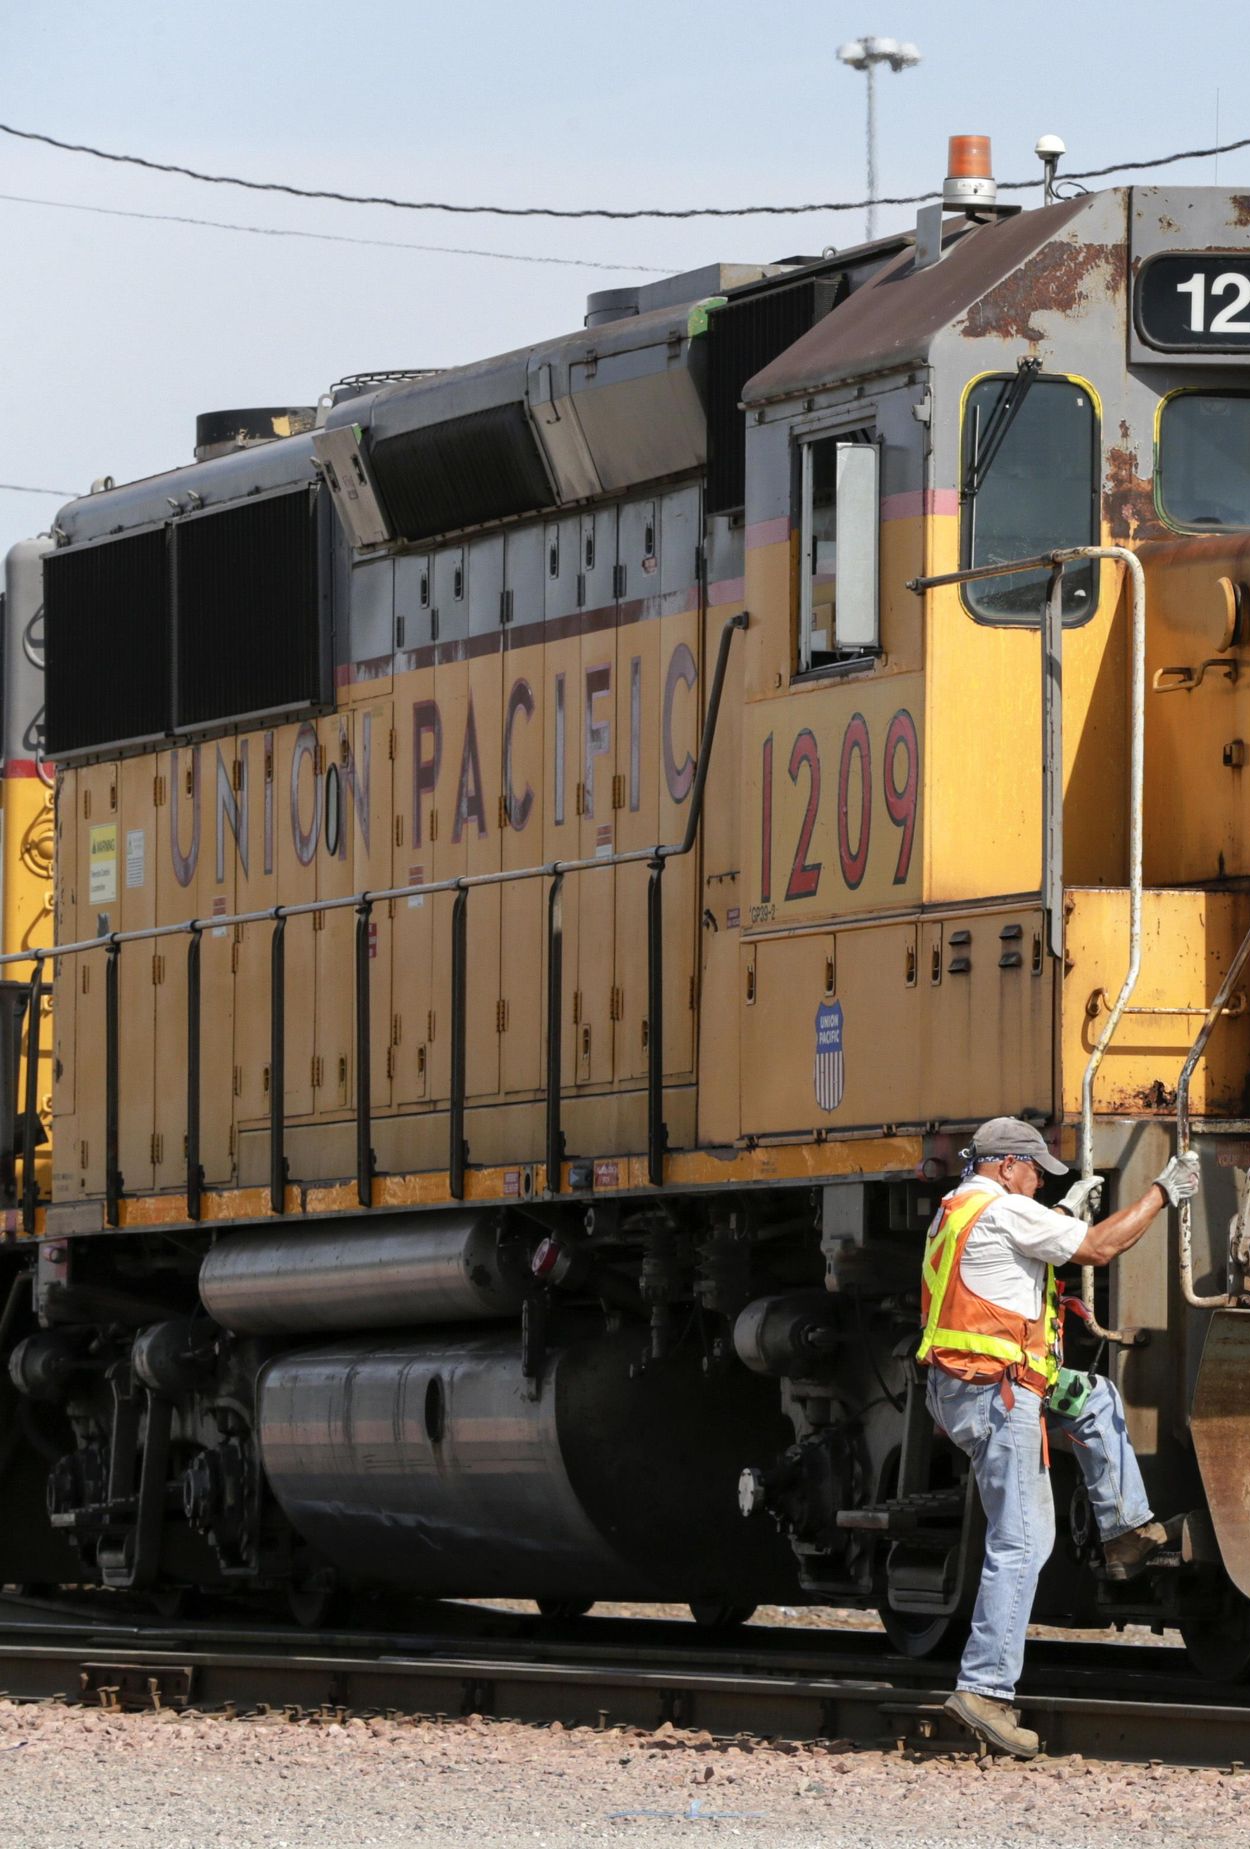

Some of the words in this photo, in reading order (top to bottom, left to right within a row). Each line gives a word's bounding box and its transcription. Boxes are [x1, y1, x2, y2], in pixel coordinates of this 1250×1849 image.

[170, 711, 371, 887] UNION
[413, 643, 698, 849] PACIFIC
[760, 708, 920, 904] 1209
[751, 903, 776, 923] GP39-2
[820, 1014, 839, 1028] UNION
[819, 1029, 840, 1045] PACIFIC
